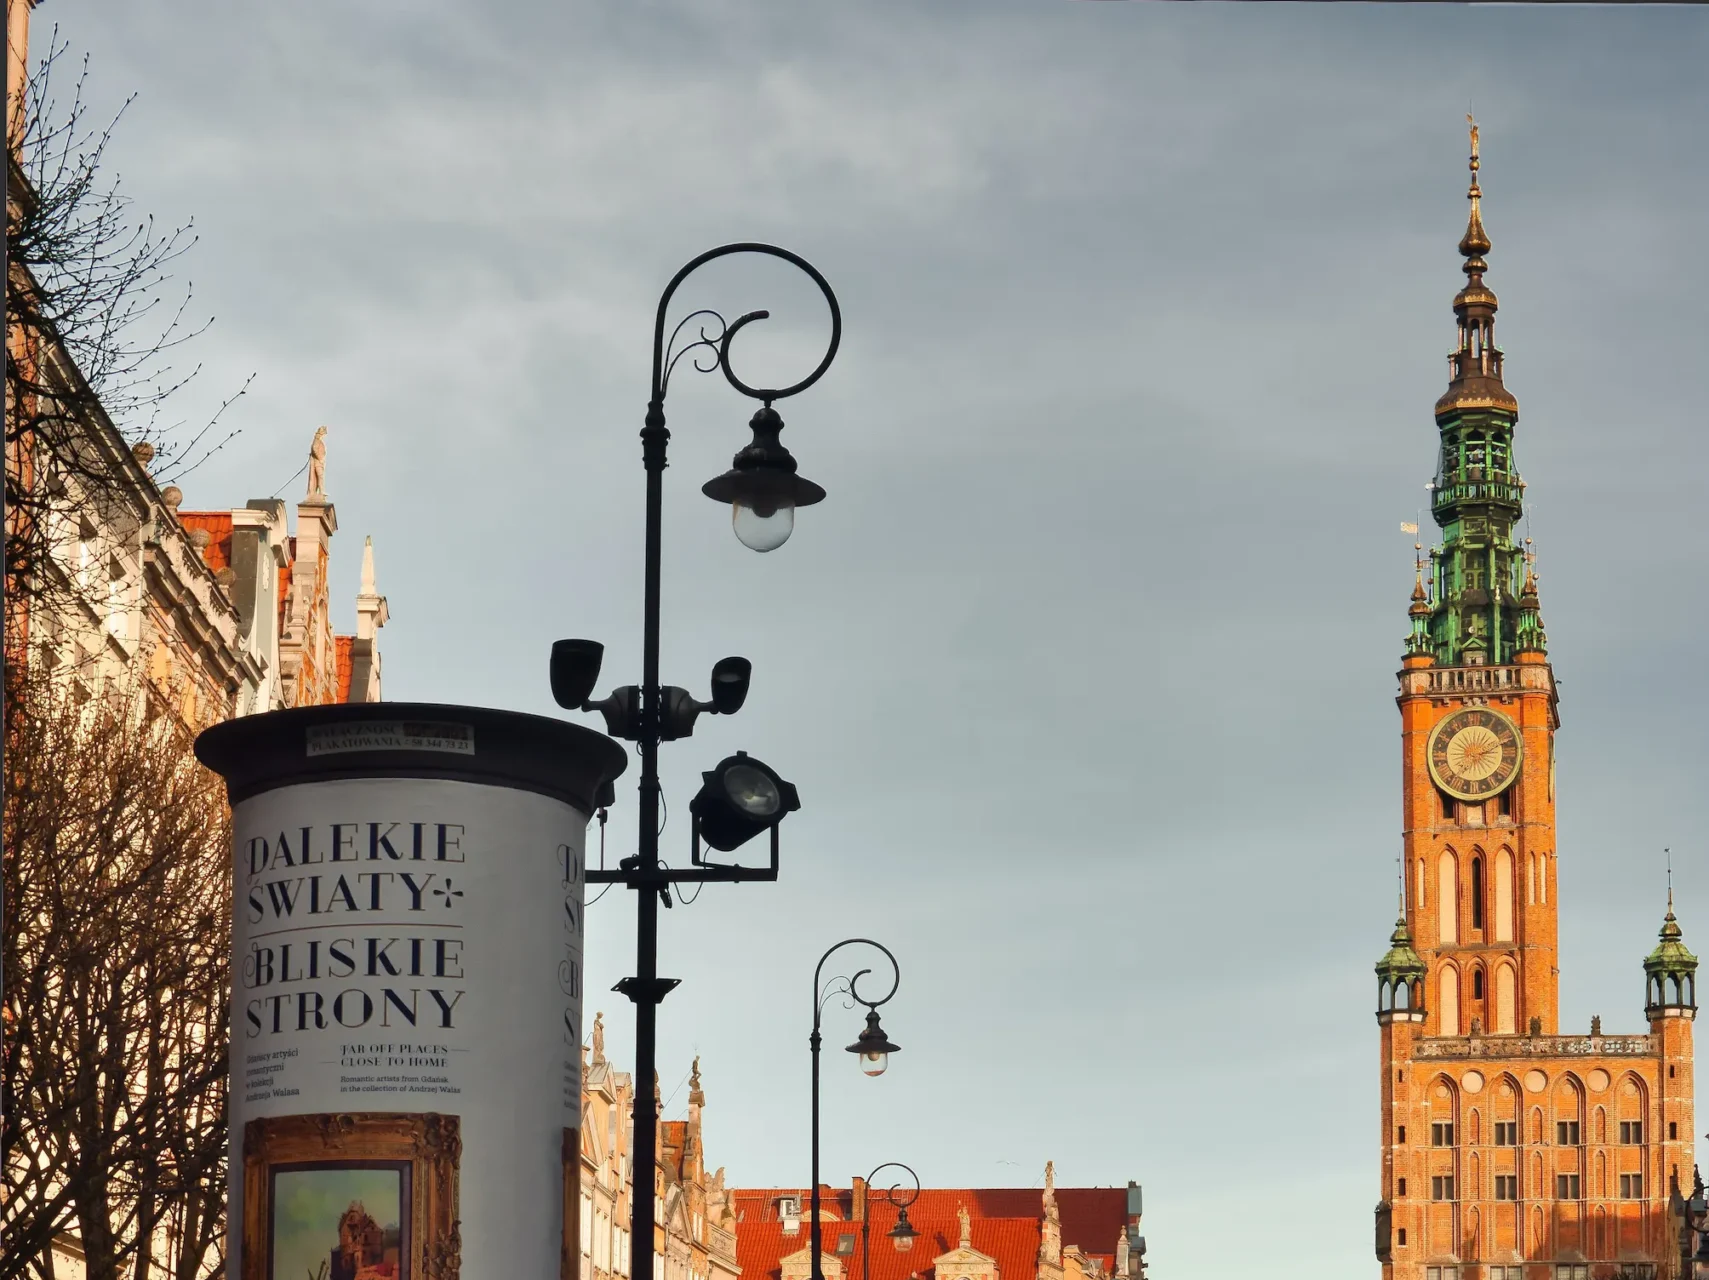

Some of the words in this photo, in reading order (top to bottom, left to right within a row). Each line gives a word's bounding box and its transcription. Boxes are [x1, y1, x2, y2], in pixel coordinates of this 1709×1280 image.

[244, 822, 465, 885] DALEKIE
[248, 872, 437, 925] ŚWIATY
[242, 938, 464, 989] BLISKIE
[246, 988, 466, 1039] STRONY
[271, 1048, 299, 1060] artyści
[341, 1044, 365, 1056] FAR
[369, 1044, 395, 1054] OFF
[399, 1044, 448, 1055] PLACES
[341, 1056, 381, 1067] CLOSE
[385, 1056, 404, 1067] TO
[408, 1057, 448, 1068] HOME
[340, 1075, 374, 1083] Romantic
[376, 1075, 400, 1083] artists
[401, 1075, 419, 1083] from
[272, 1087, 300, 1098] Walasa
[362, 1085, 398, 1093] collection
[409, 1085, 438, 1094] Andrzej
[439, 1086, 461, 1094] Walas
